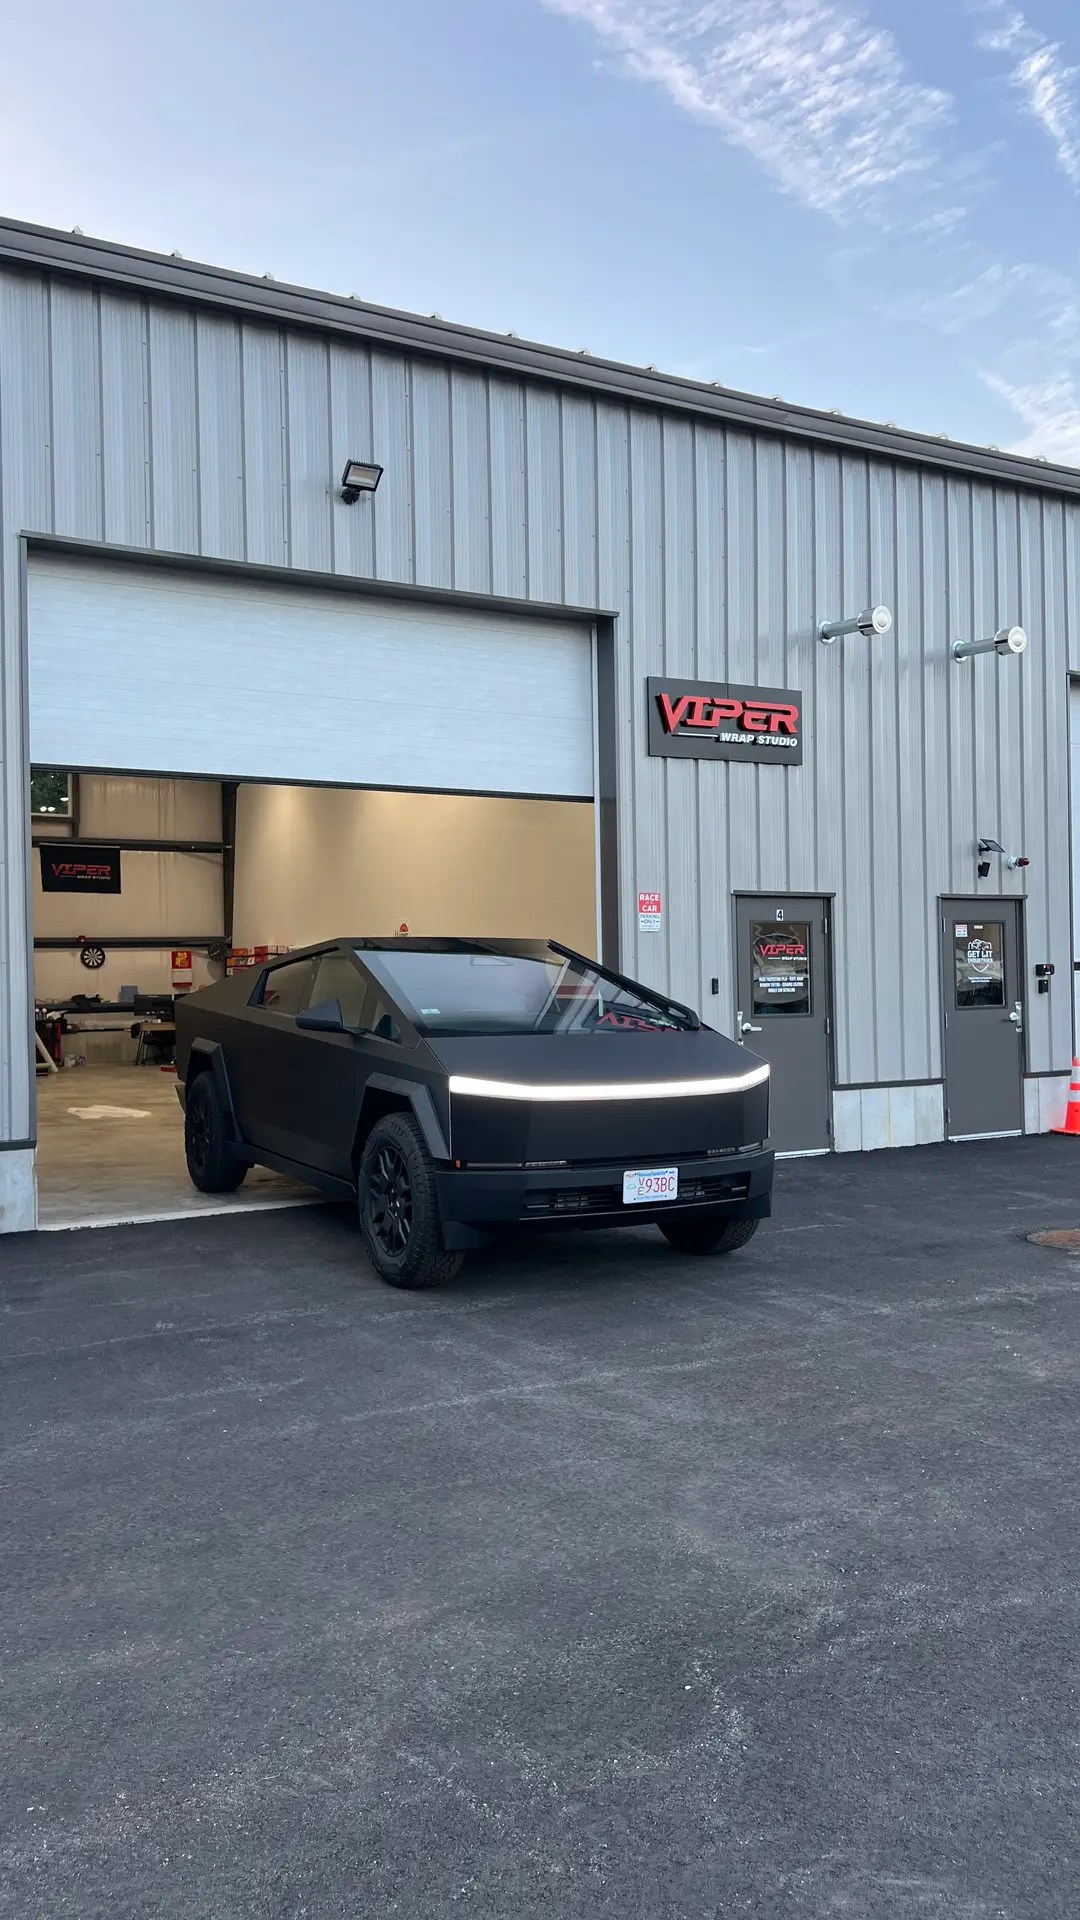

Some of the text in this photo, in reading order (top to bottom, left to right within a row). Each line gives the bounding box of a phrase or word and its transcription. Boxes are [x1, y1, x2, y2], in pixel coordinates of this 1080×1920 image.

[657, 693, 799, 733] VIPER
[718, 733, 798, 747] WRAP STUDIO
[51, 863, 111, 875] VIPER
[640, 893, 660, 901] RACE
[642, 904, 658, 912] CAR
[760, 944, 805, 956] VIPER
[967, 950, 993, 958] GET LIT
